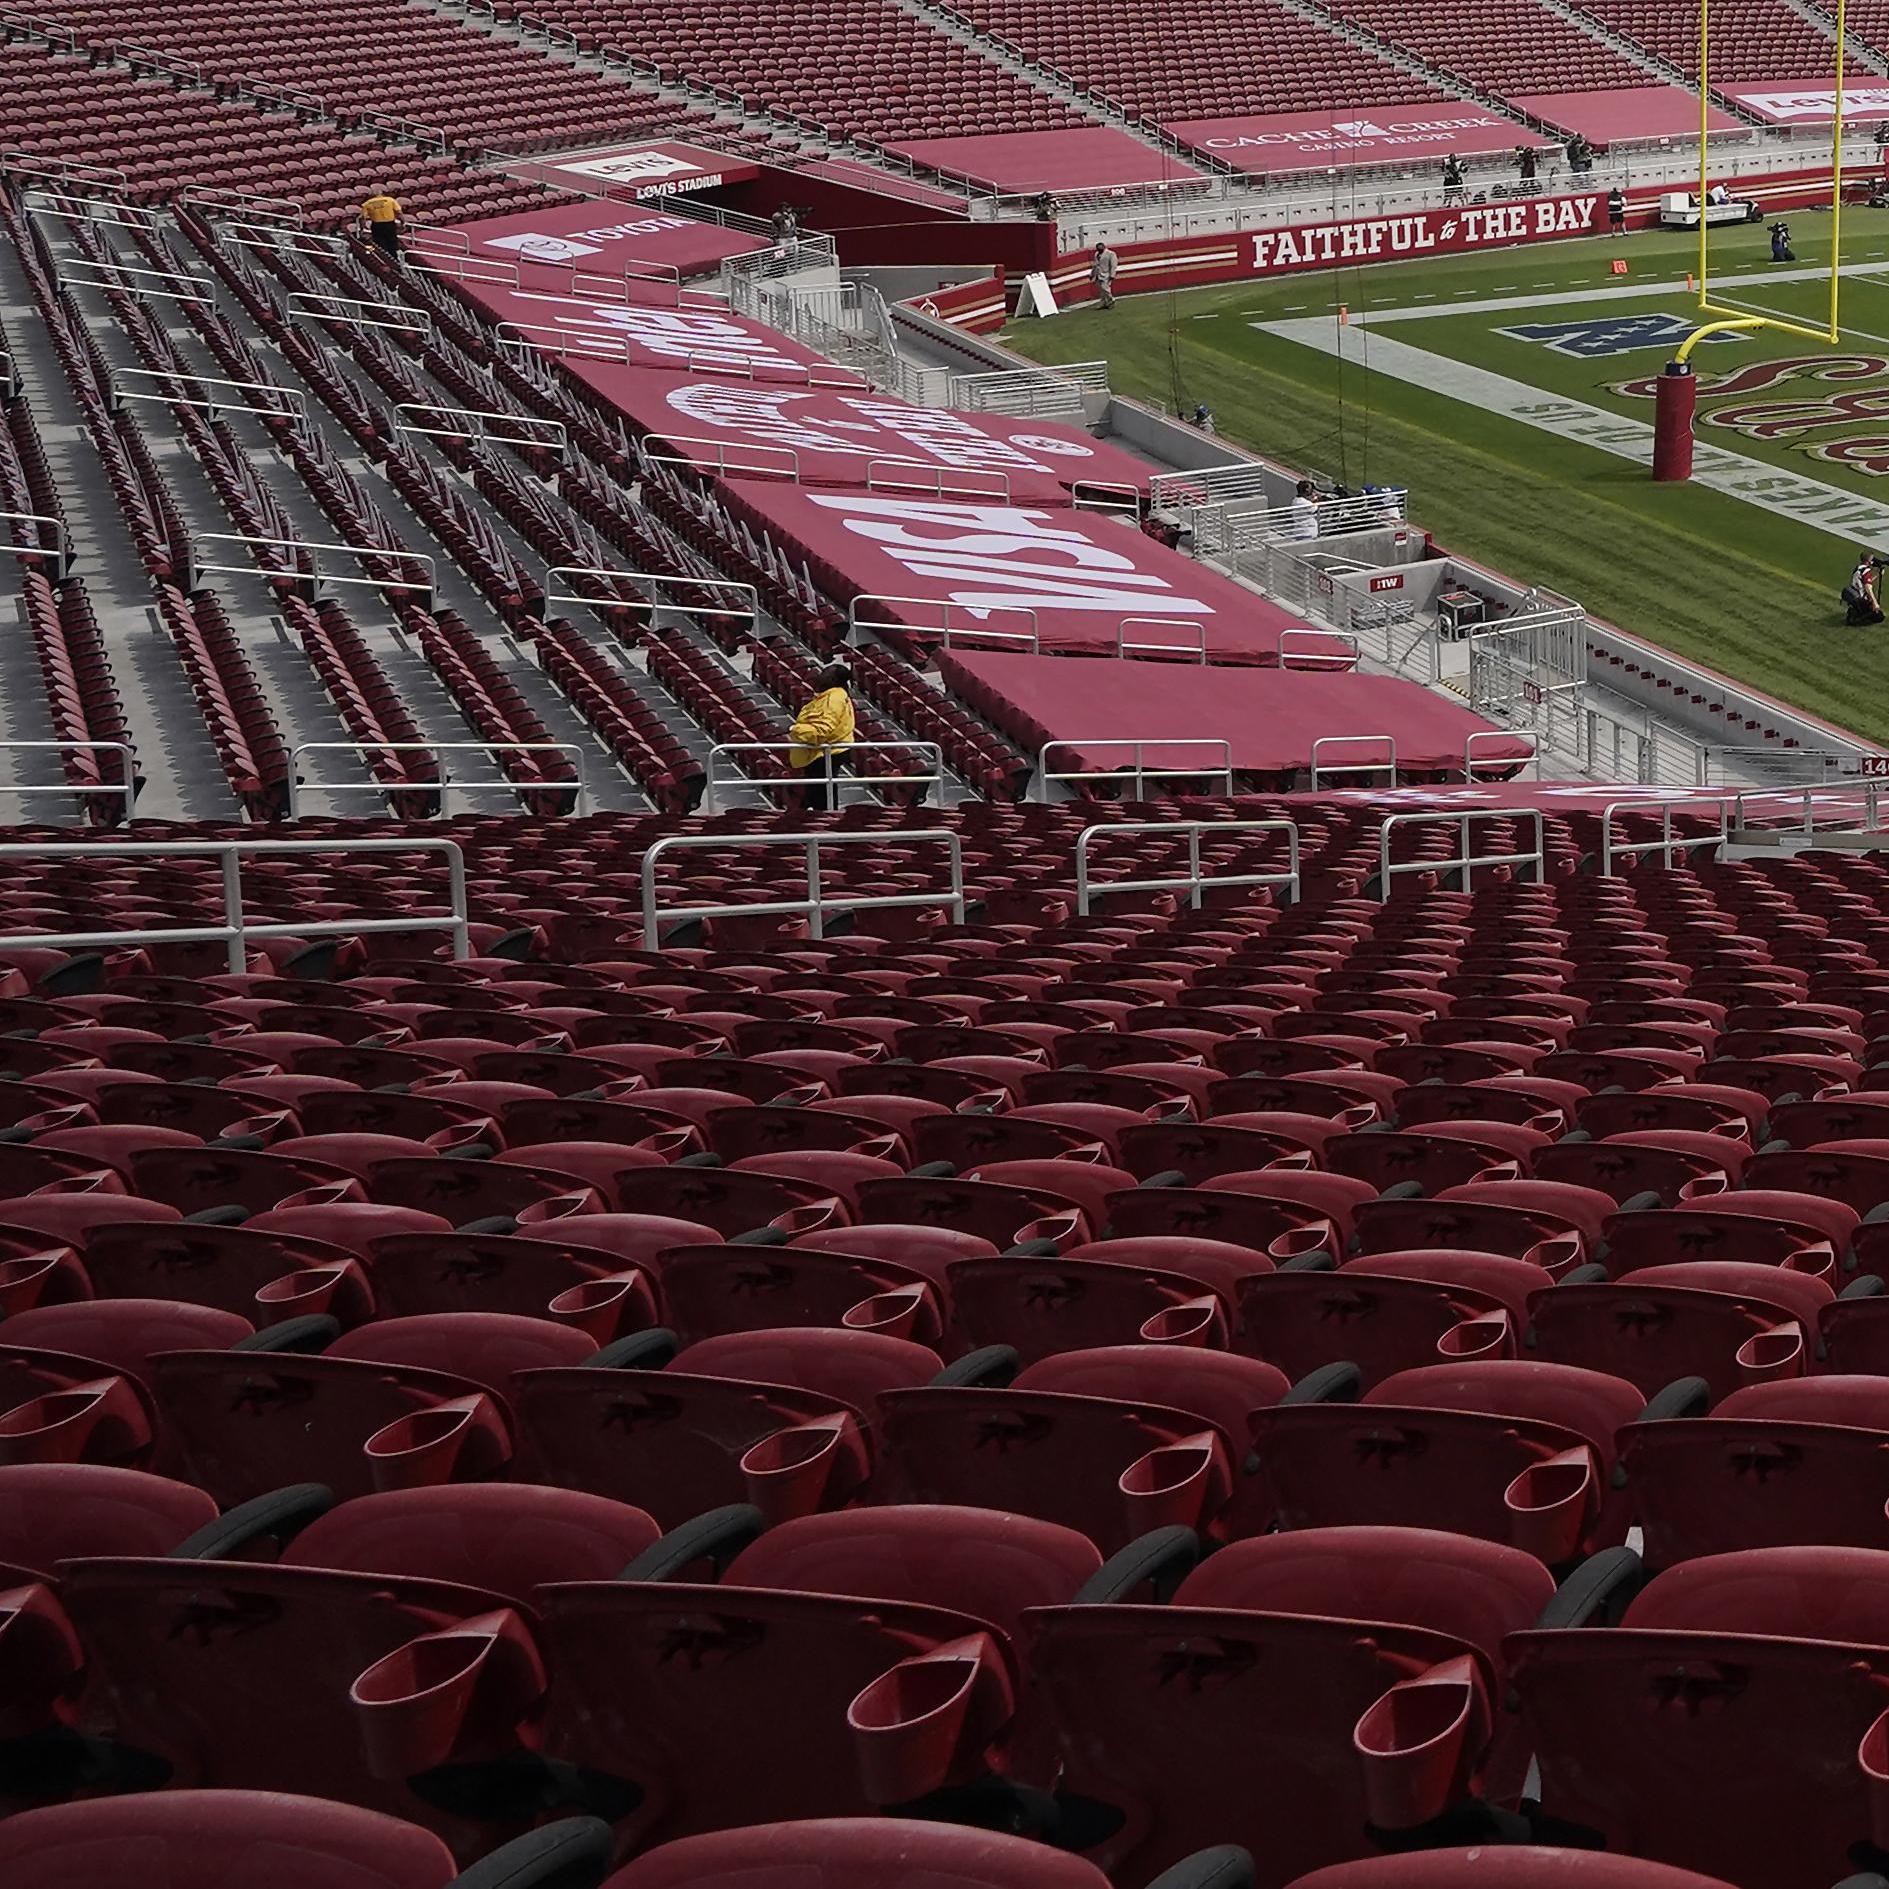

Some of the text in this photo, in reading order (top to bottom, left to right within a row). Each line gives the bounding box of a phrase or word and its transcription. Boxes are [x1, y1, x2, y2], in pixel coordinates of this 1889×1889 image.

[1206, 115, 1502, 149] CACHE CREEK
[1299, 131, 1457, 152] CASINO RESORT
[678, 173, 723, 194] STADIUM
[565, 216, 698, 243] TOYOTA
[1253, 197, 1597, 268] FAITHFUL to THE BAY
[806, 493, 1216, 619] VISA
